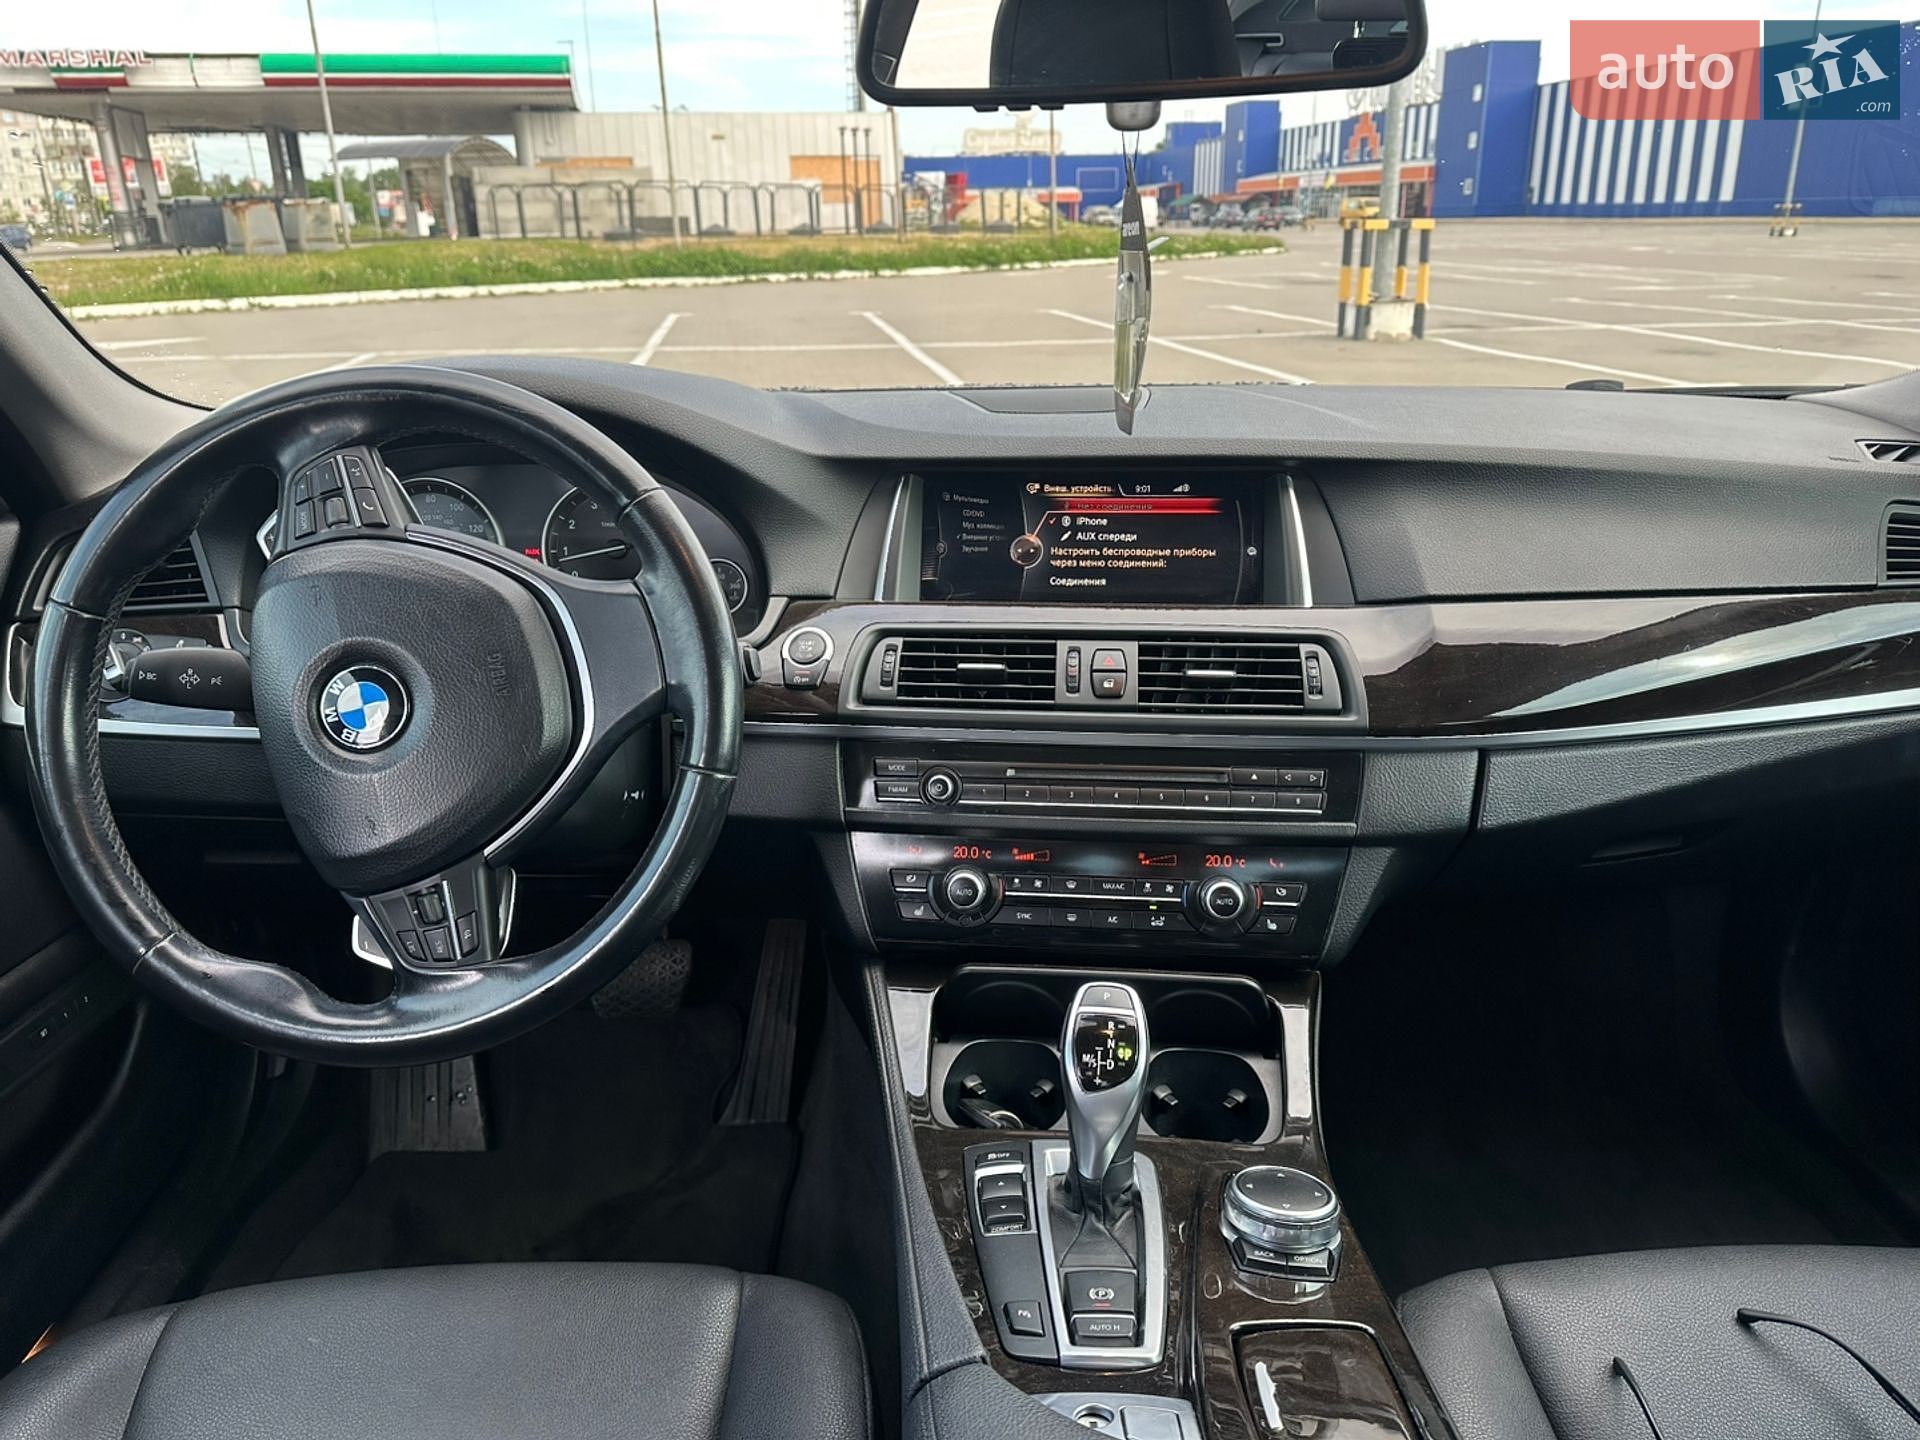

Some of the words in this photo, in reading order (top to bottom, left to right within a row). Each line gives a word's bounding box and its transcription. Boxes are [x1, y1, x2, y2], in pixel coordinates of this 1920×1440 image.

[0, 48, 153, 67] MARSHAL
[1135, 485, 1151, 494] 9:01
[425, 494, 437, 503] 80
[449, 503, 465, 512] 100
[591, 502, 598, 510] 3
[568, 520, 576, 530] 2
[1076, 516, 1108, 526] iPhone
[468, 524, 484, 533] 120
[1076, 532, 1096, 541] AUX
[1098, 533, 1138, 542] спереди
[563, 546, 568, 556] 1
[1050, 547, 1100, 556] Настроить
[1102, 546, 1171, 557] беспроводные
[1173, 546, 1217, 557] приборы
[1051, 559, 1077, 568] через
[1079, 559, 1105, 567] меню
[1107, 558, 1167, 568] соединений:
[1050, 576, 1107, 587] Соединения
[324, 678, 360, 744] BMW
[953, 846, 979, 859] 20.0
[1205, 854, 1232, 868] 20.0
[956, 888, 973, 896] AUTO
[1016, 912, 1032, 920] SYNC
[1103, 992, 1110, 1000] P
[1108, 1021, 1115, 1030] R
[1107, 1039, 1115, 1048] N
[1106, 1060, 1114, 1070] D
